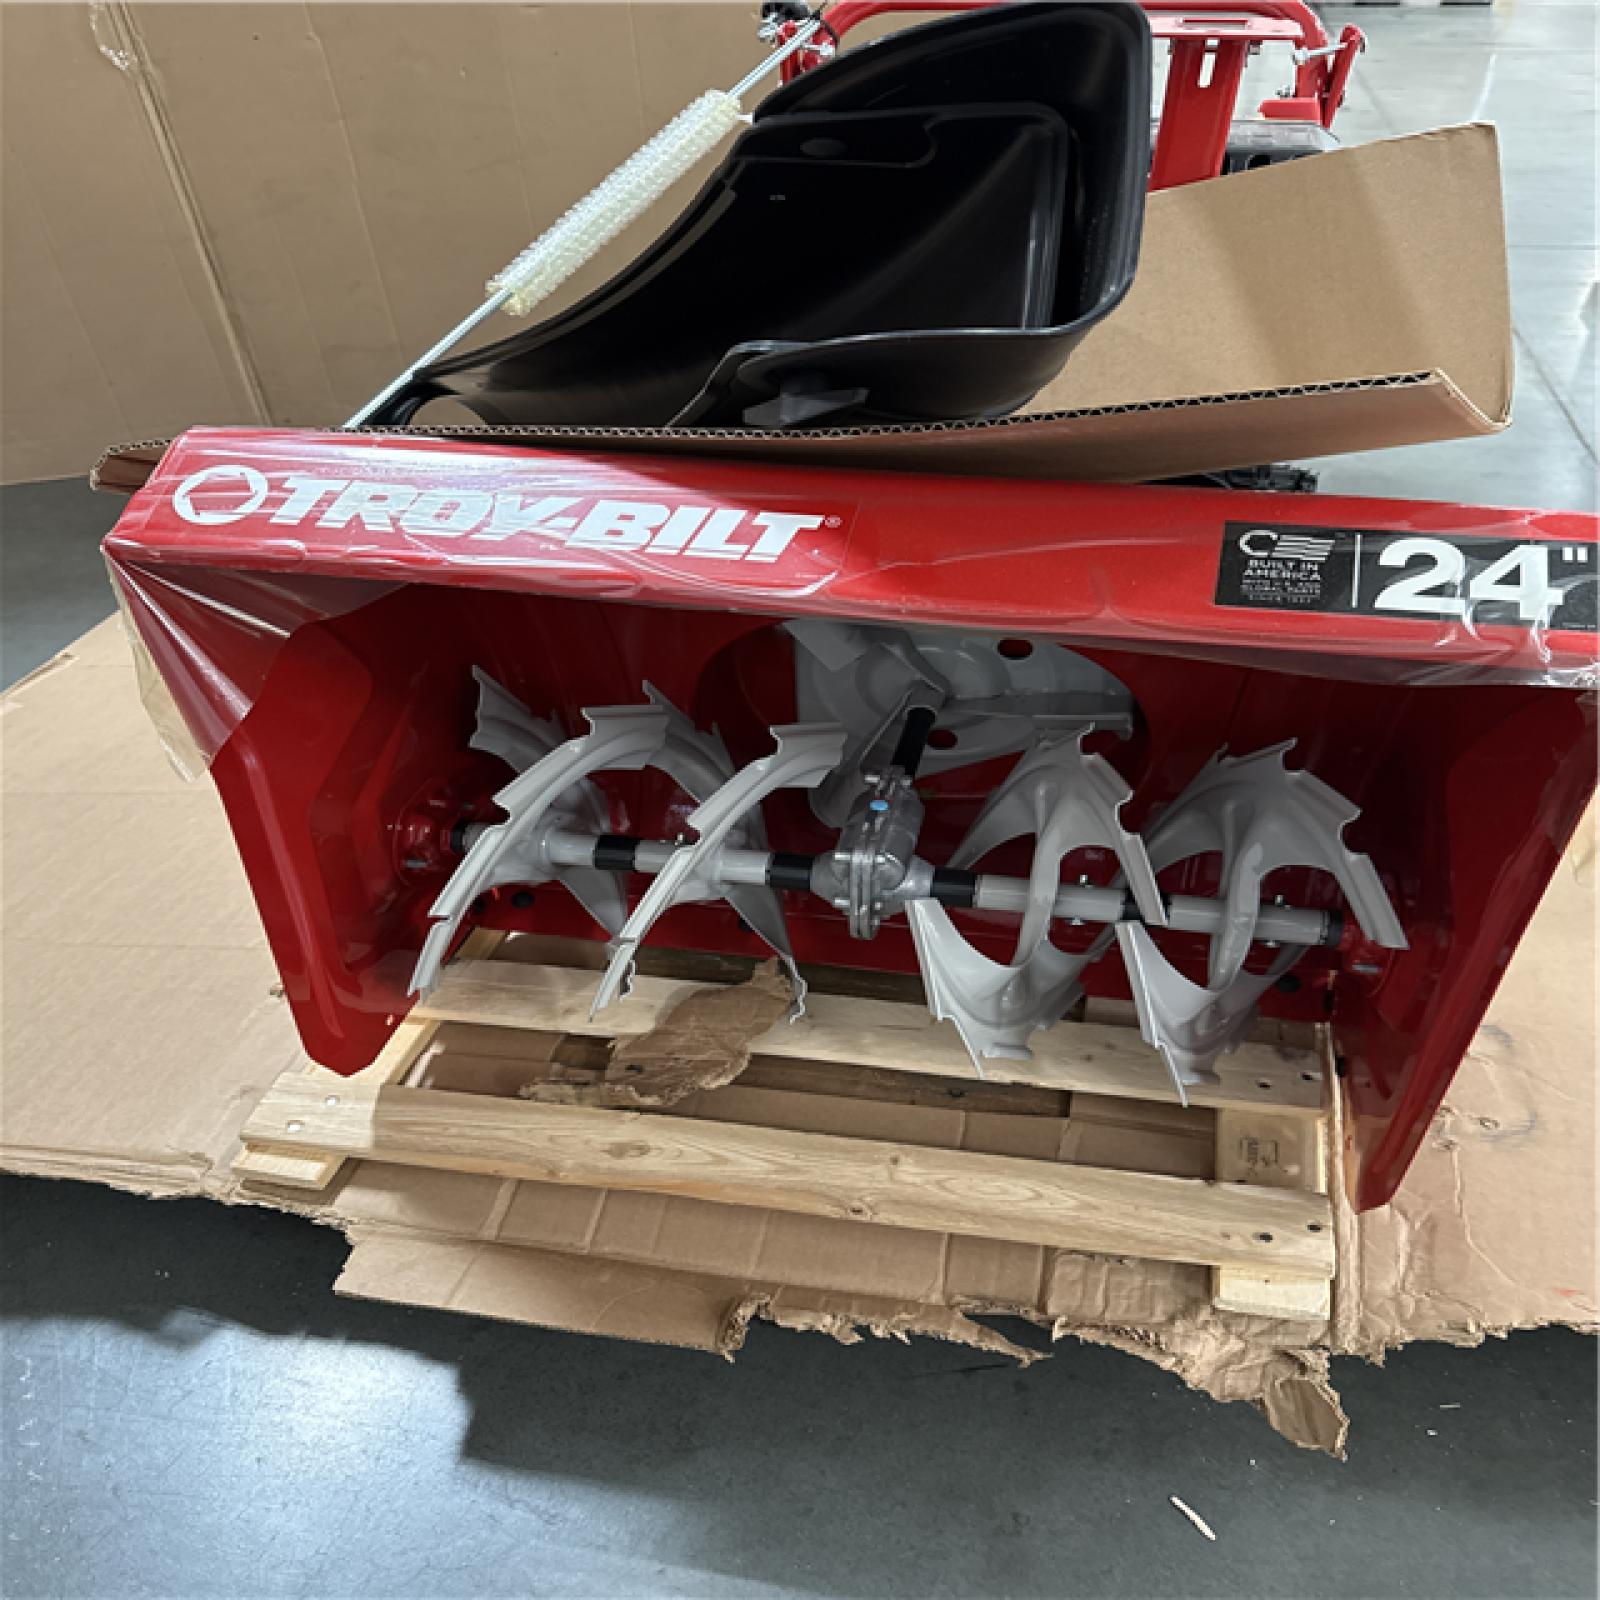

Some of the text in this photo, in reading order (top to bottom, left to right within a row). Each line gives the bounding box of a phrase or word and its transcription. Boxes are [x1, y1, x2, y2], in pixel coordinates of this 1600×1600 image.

[269, 476, 825, 563] TROY-BILT
[1248, 559, 1319, 571] BUILT IN
[1243, 568, 1321, 581] AMERICA
